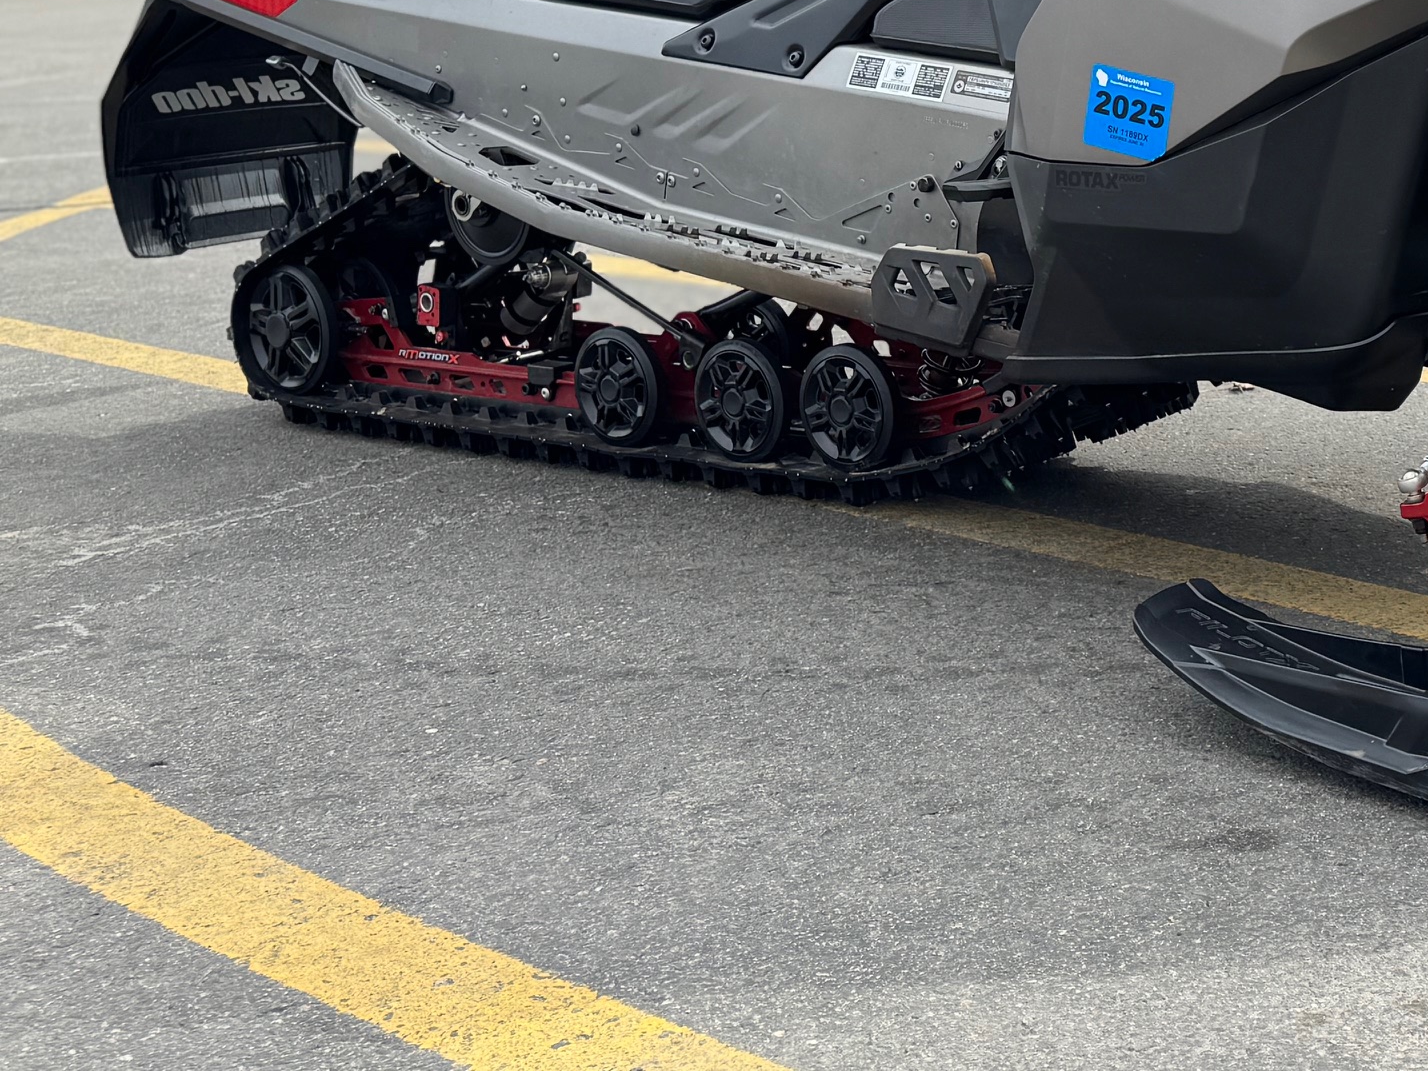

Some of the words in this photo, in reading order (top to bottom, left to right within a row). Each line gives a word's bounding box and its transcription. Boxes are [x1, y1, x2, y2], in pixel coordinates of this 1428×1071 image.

[1117, 73, 1150, 87] Wisconsin
[1093, 91, 1166, 128] 2025
[1107, 125, 1119, 134] SN
[1055, 169, 1119, 189] ROTAX
